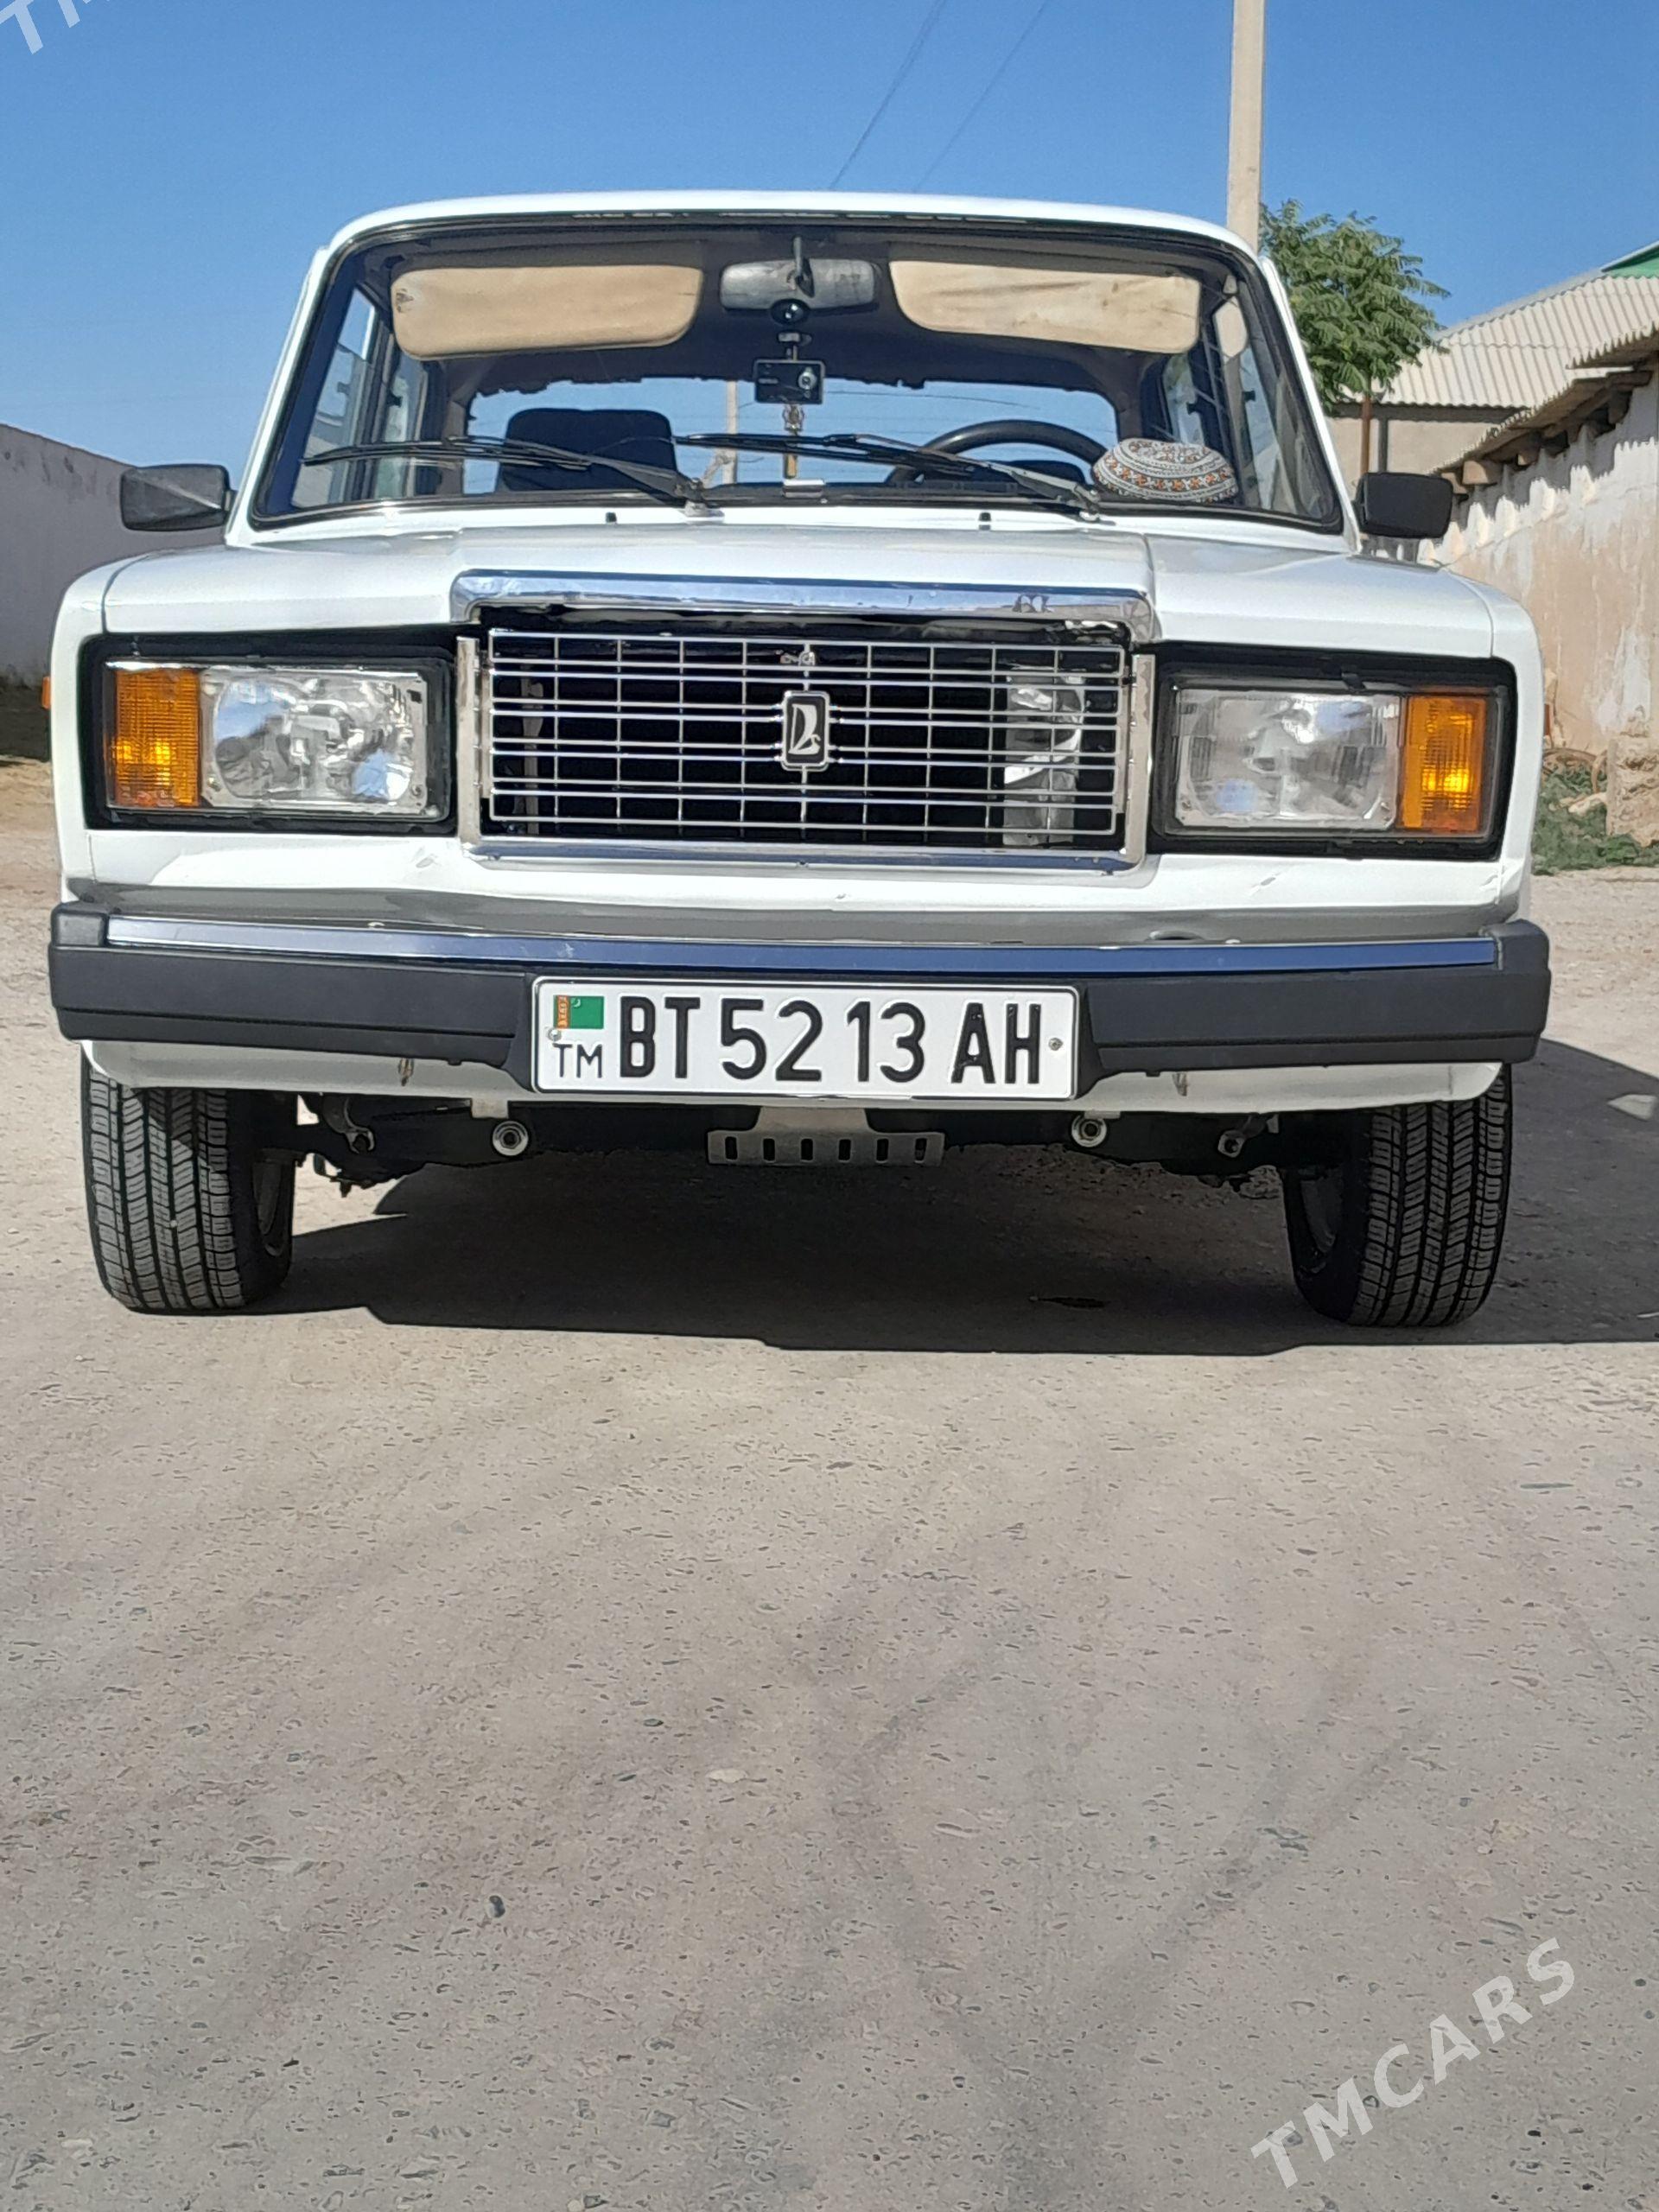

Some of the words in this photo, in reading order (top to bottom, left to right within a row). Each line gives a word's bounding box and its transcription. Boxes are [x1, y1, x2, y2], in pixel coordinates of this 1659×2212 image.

[553, 1042, 603, 1079] TM
[620, 995, 701, 1079] BT
[720, 998, 823, 1082] 52
[846, 1000, 925, 1083] 13
[950, 1001, 1042, 1084] AH
